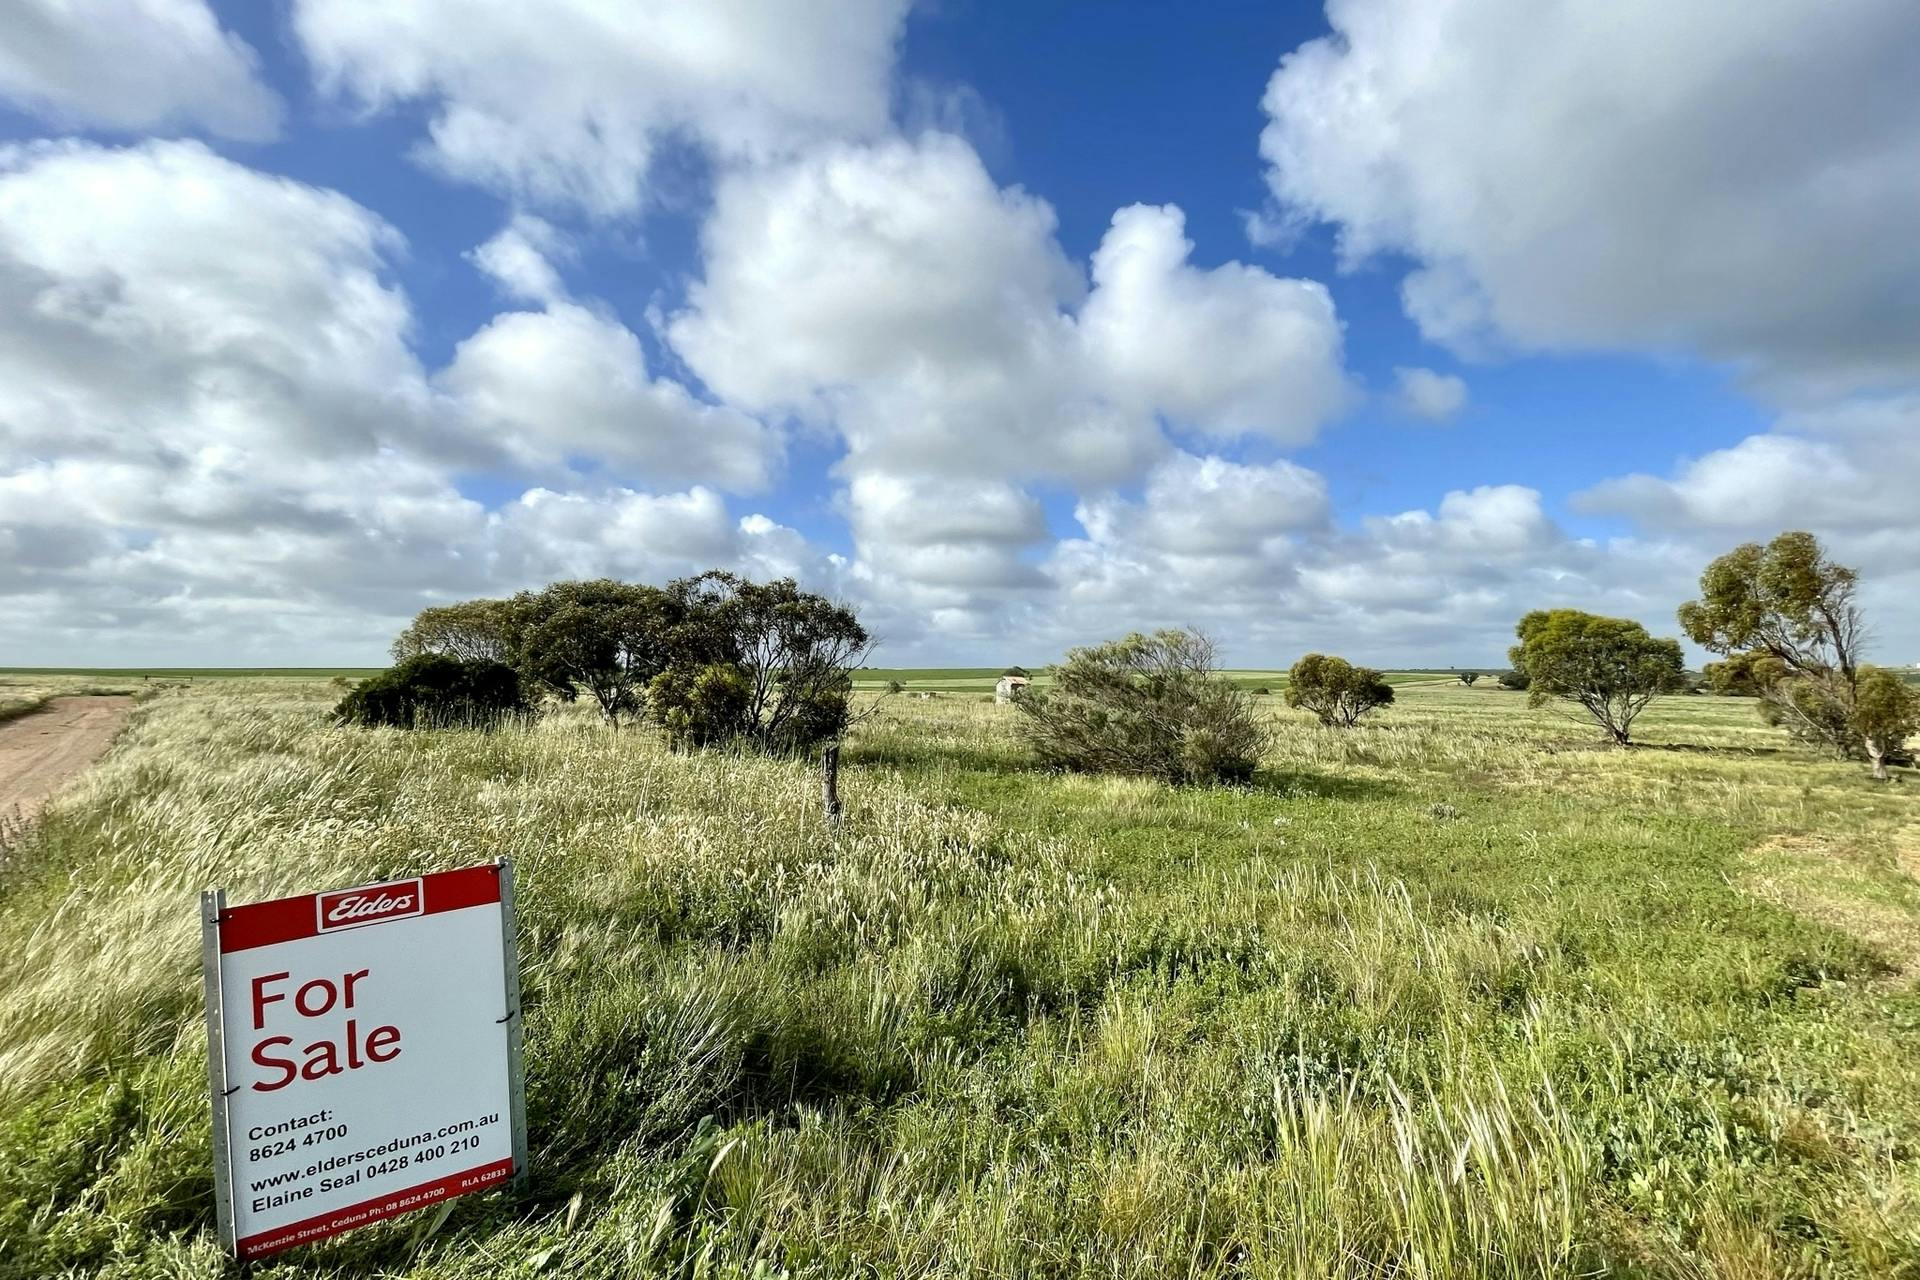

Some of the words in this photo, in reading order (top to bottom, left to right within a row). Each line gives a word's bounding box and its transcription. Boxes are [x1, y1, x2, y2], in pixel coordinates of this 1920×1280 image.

[328, 892, 415, 922] Elders
[251, 968, 370, 1030] For
[250, 1018, 402, 1093] Sale
[249, 1108, 333, 1141] Contact:
[249, 1138, 296, 1162] 8624
[302, 1123, 348, 1148] 4700
[250, 1112, 500, 1192] www.eldersceduna.com.au
[252, 1187, 314, 1214] Elaine
[319, 1170, 360, 1194] Seal
[366, 1156, 409, 1180] 0428
[414, 1144, 446, 1165] 400
[450, 1134, 480, 1155] 210
[461, 1175, 479, 1188] RLA
[480, 1168, 506, 1182] 62833
[247, 1235, 295, 1255] McKenzie
[297, 1224, 330, 1240] Street,
[331, 1212, 367, 1228] Ceduna
[369, 1206, 384, 1217] Ph:
[386, 1201, 398, 1211] 08
[399, 1194, 421, 1207] 8624
[422, 1187, 445, 1201] 4700
